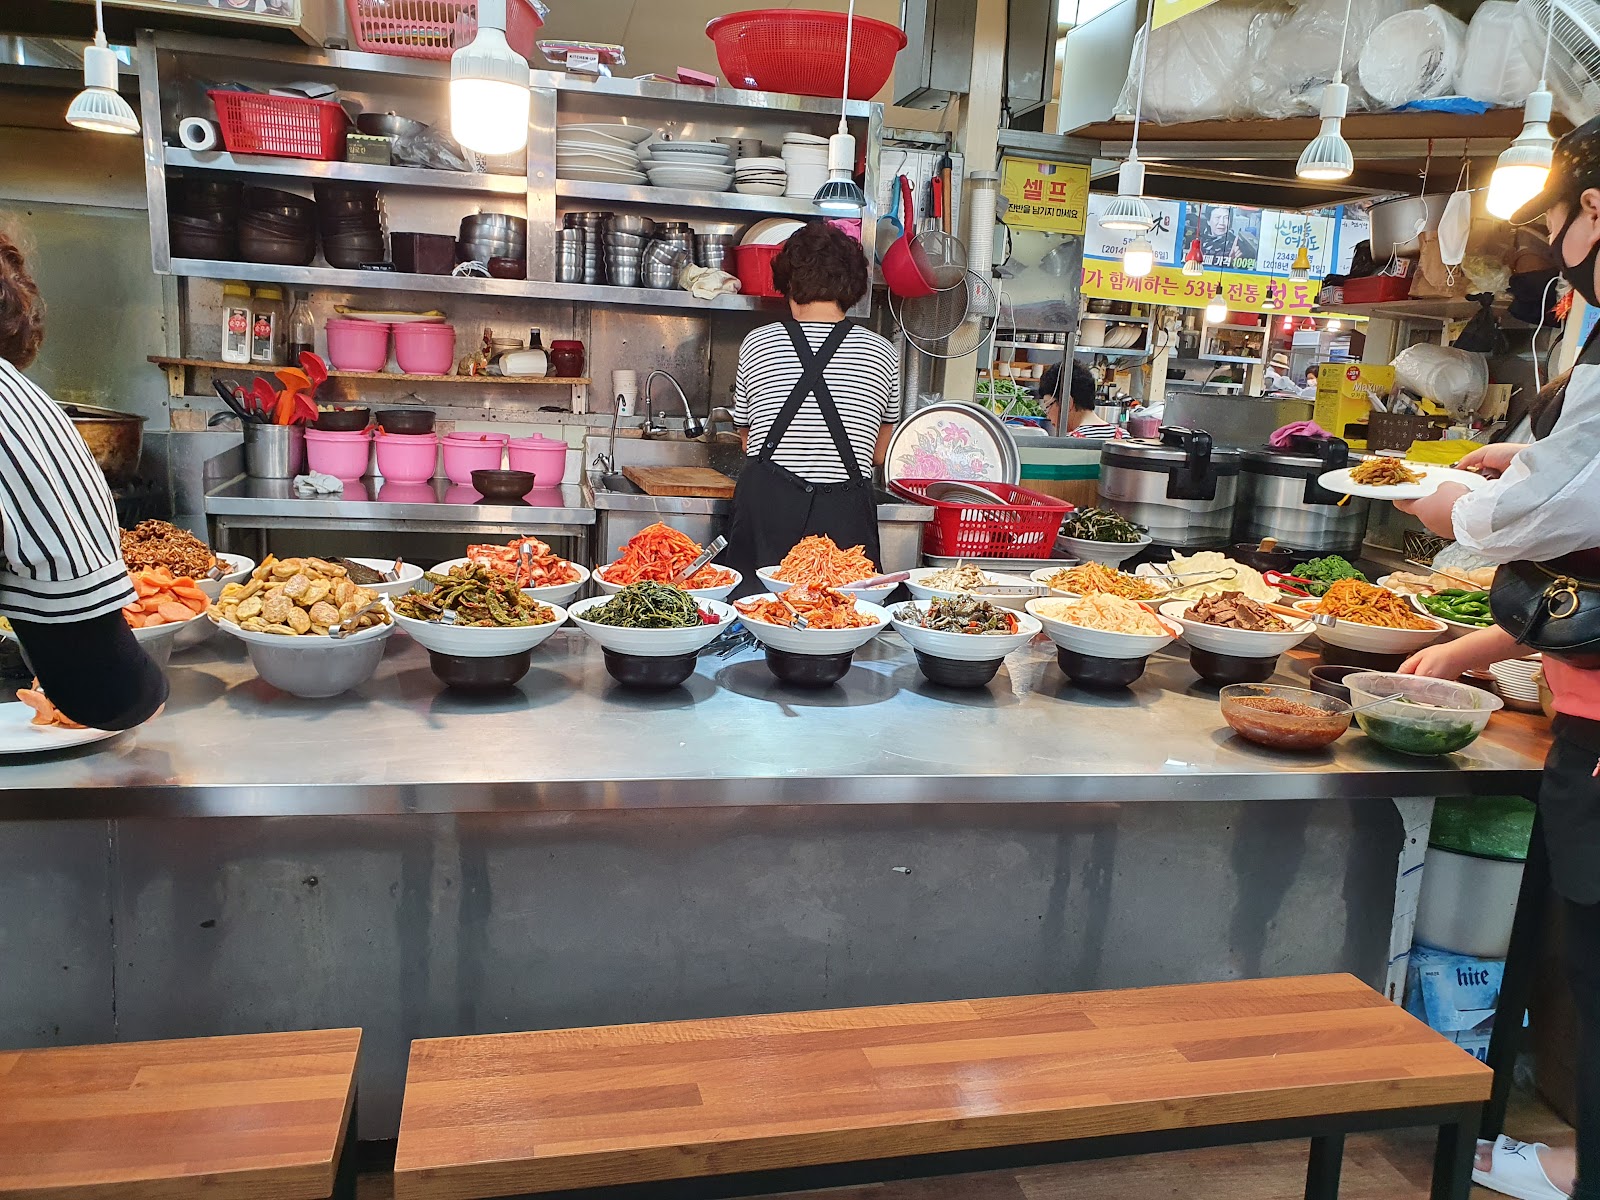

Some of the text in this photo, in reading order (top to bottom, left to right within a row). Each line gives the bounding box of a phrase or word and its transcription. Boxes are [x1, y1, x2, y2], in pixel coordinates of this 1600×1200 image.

[1032, 206, 1055, 216] 남기지
[1056, 208, 1078, 219] 마세요
[1214, 255, 1232, 267] 가격
[1232, 257, 1257, 269] 100원
[1109, 271, 1179, 295] 함께하는
[1227, 282, 1260, 303] 전통
[1456, 966, 1490, 987] hite
